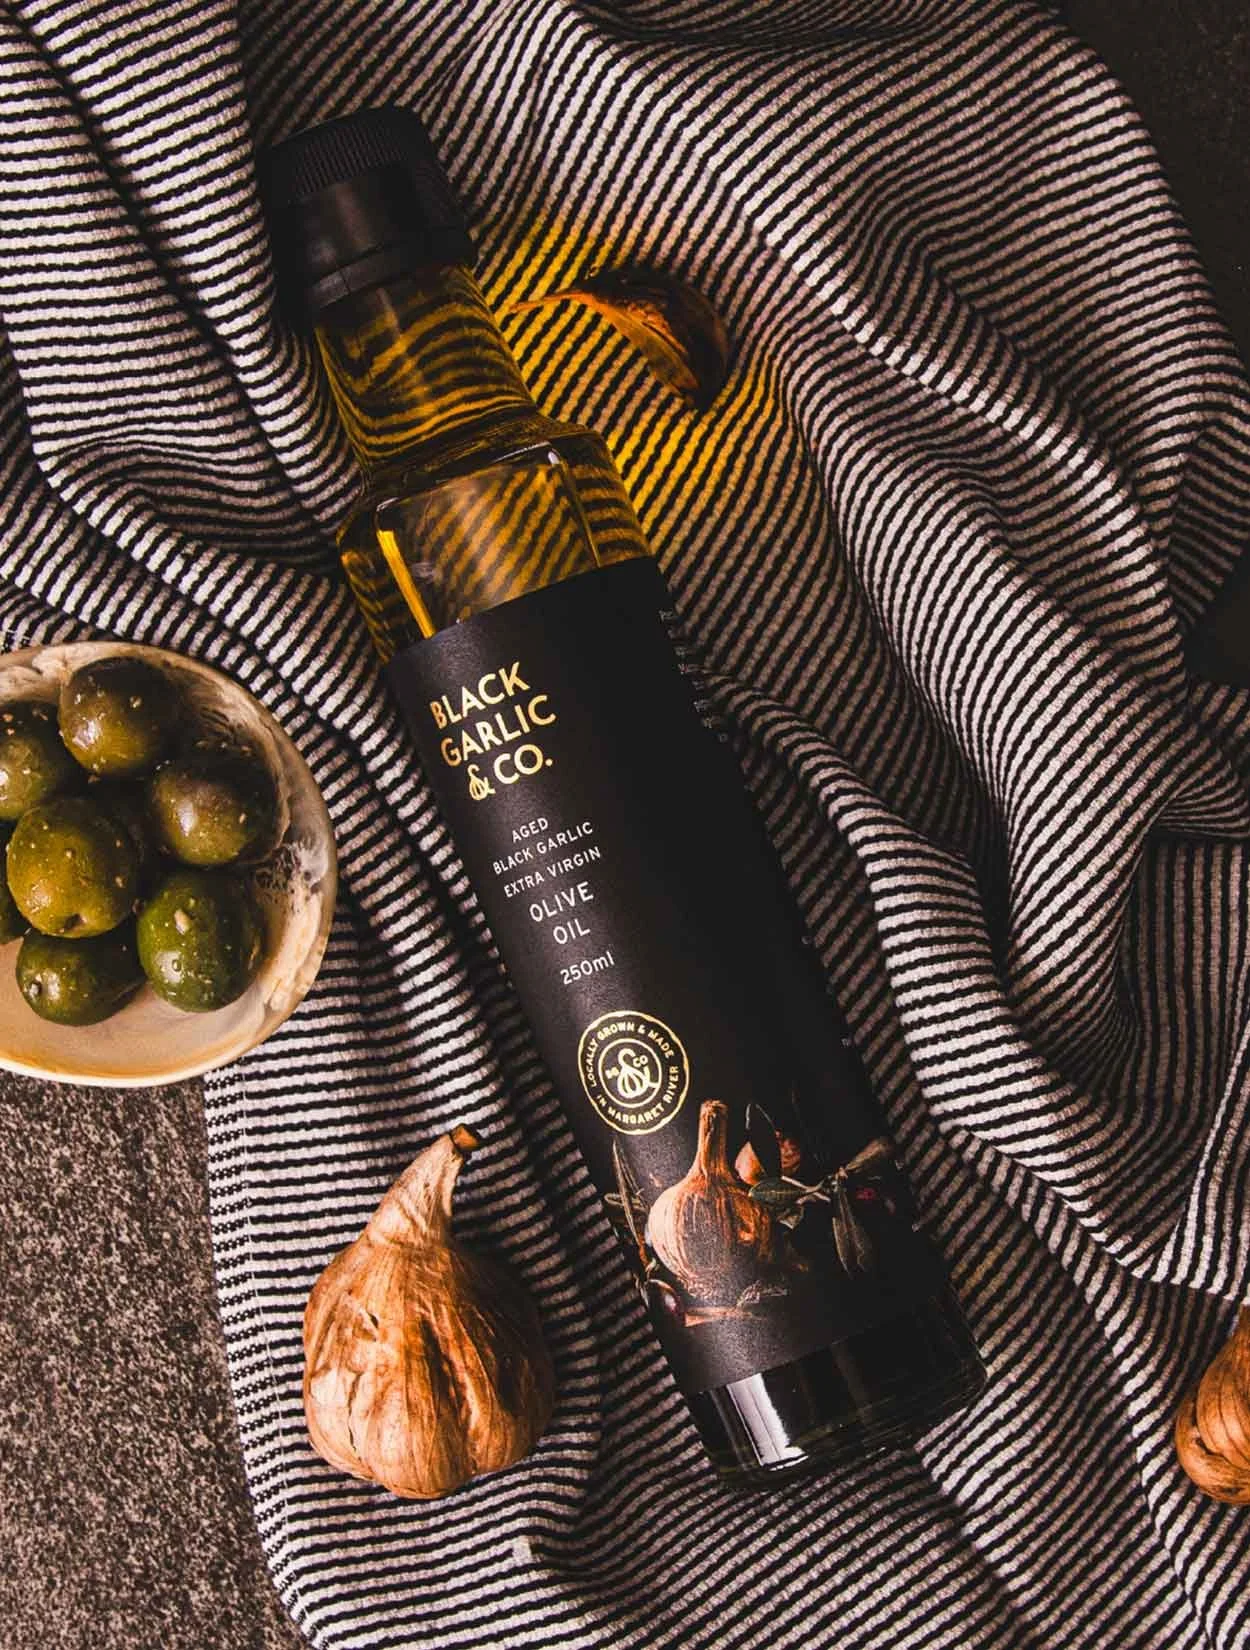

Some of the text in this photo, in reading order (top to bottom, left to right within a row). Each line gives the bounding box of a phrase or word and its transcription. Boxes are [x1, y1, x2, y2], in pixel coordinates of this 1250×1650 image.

[429, 661, 530, 730] BLACK
[440, 694, 557, 767] GARLIC
[466, 743, 553, 801] & CO.
[493, 821, 594, 875] BLACK GARLIC
[511, 817, 549, 844] AGED
[503, 846, 602, 899] EXTRA VIRGIN
[529, 881, 594, 923] OLIVE
[552, 918, 591, 945] OIL
[559, 951, 615, 985] 250ml
[585, 1038, 599, 1088] LOCALLY
[597, 1021, 635, 1041] GROWN
[648, 1029, 675, 1059] MADE
[607, 1104, 665, 1124] MARGARET
[663, 1065, 680, 1103] RIVER
